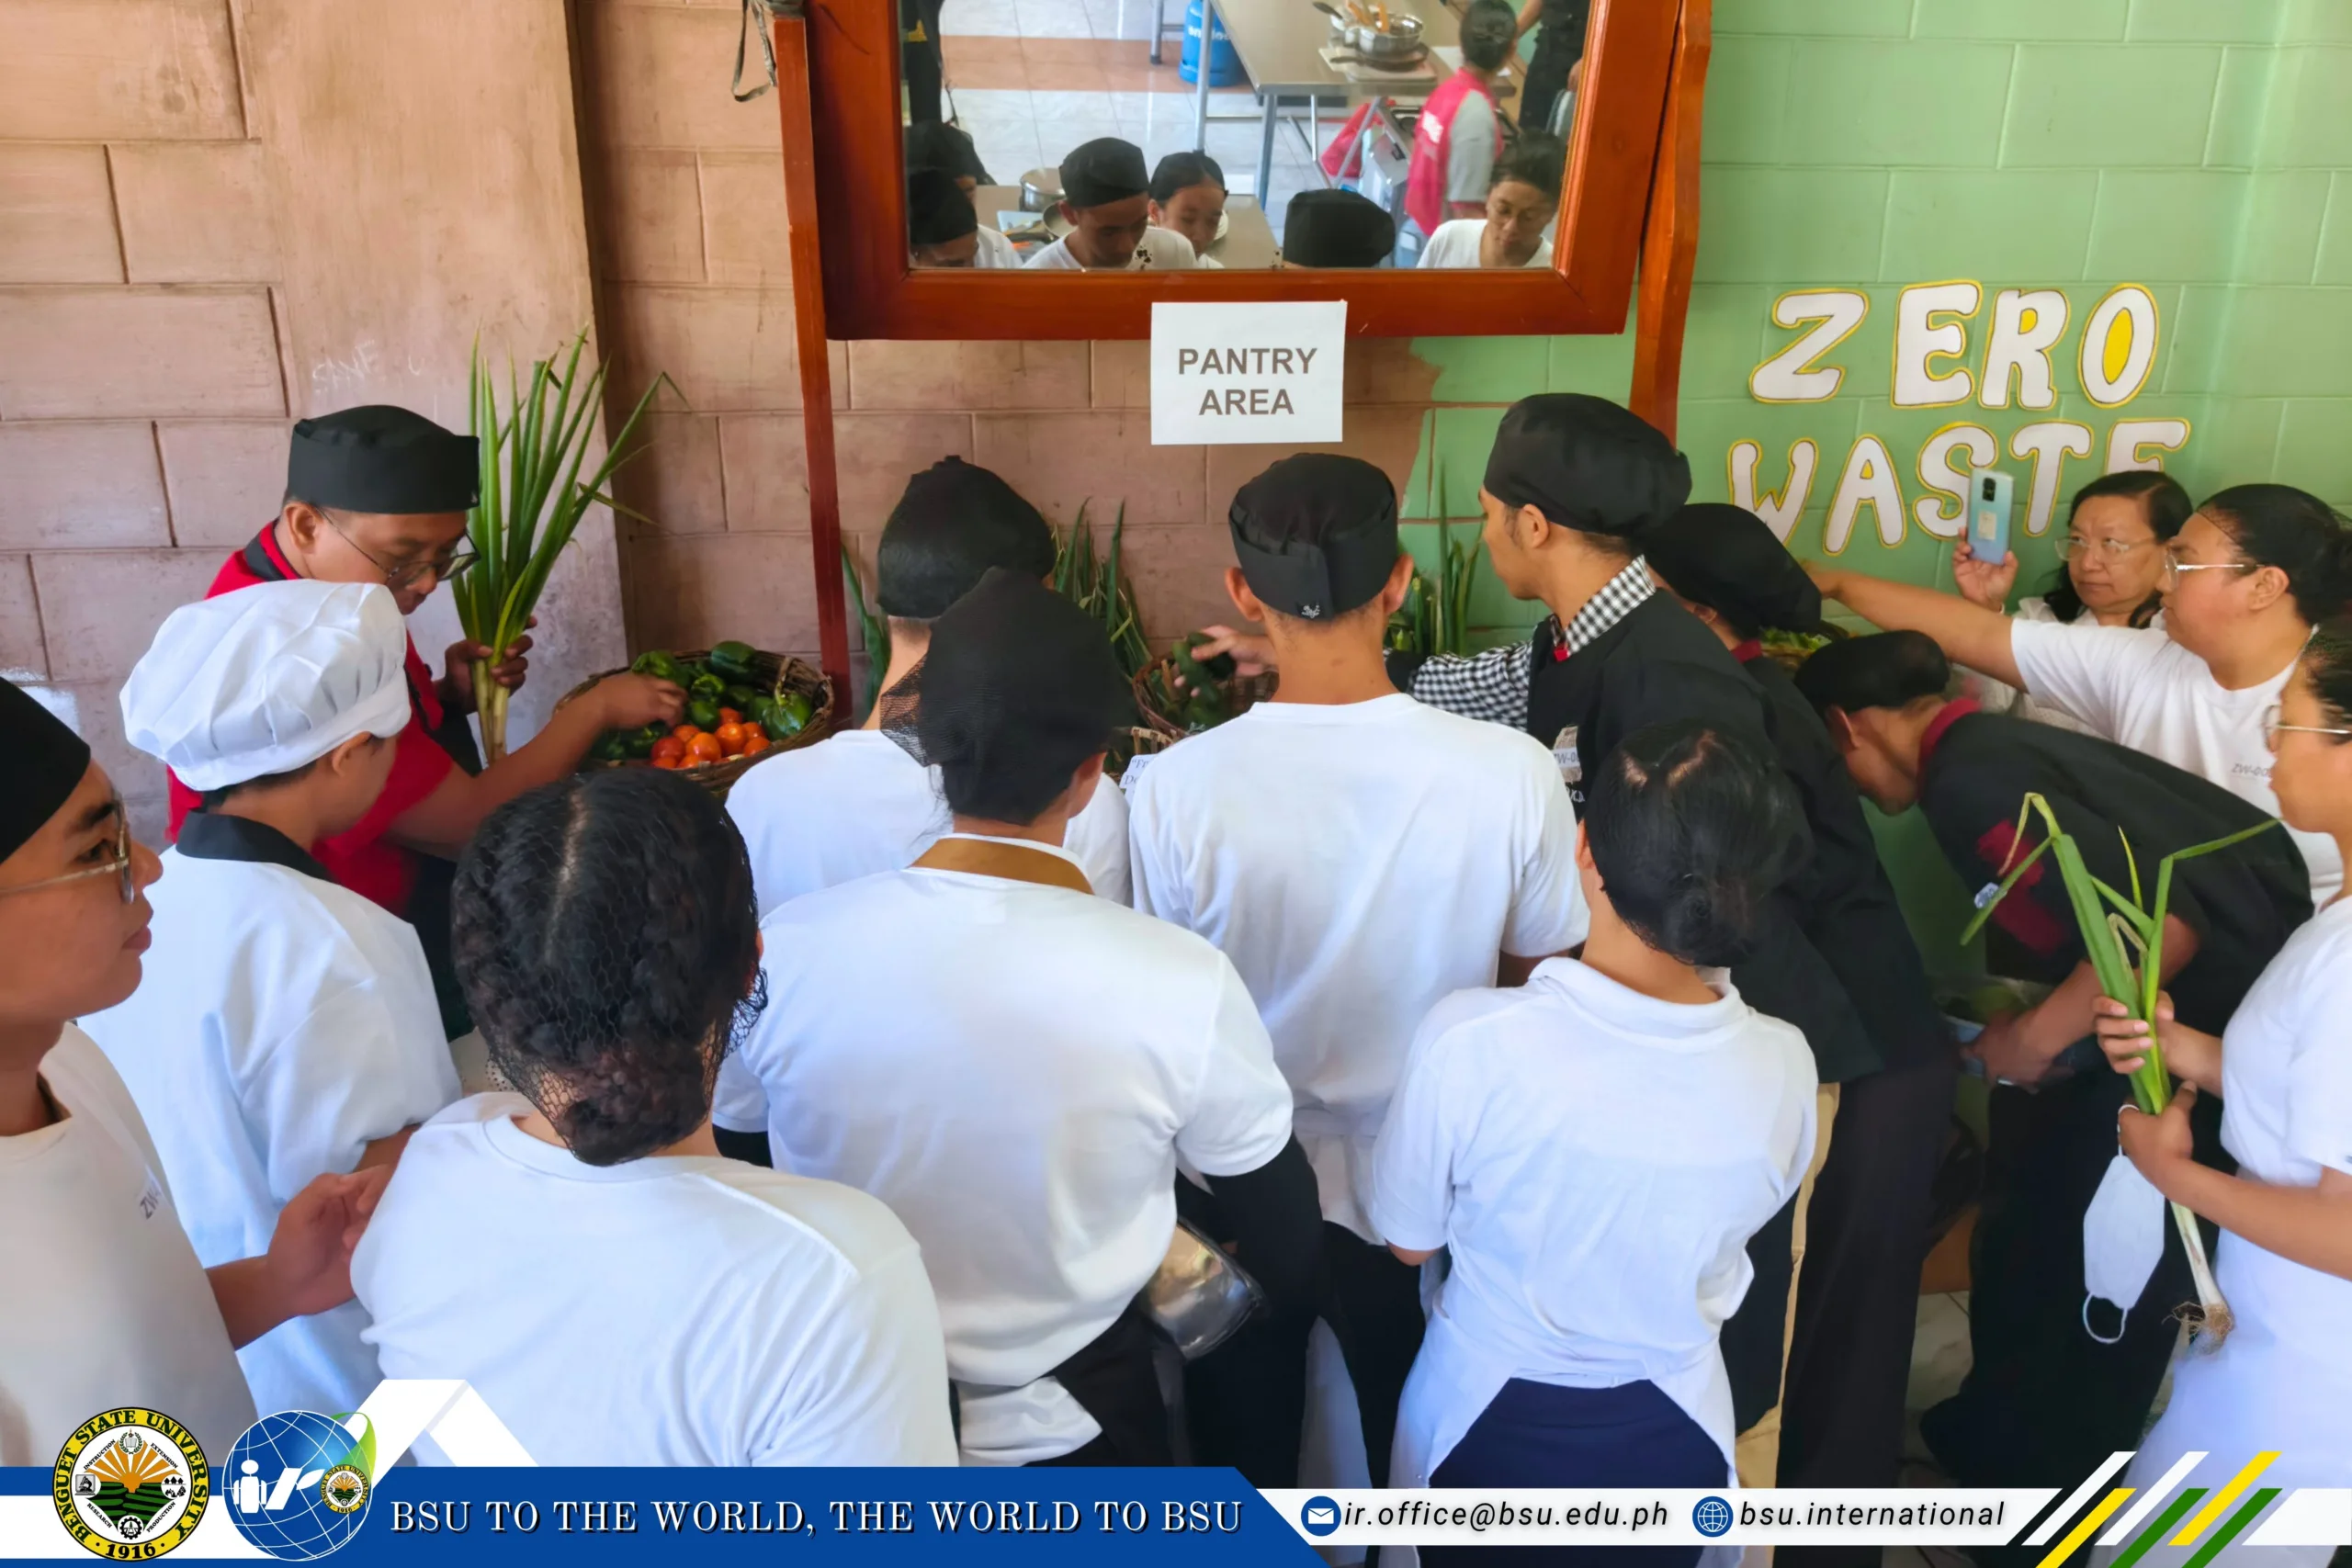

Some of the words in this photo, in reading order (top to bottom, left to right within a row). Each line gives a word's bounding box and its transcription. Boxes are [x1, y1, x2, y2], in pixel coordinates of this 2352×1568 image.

[1749, 280, 2159, 410] ZERO
[1179, 348, 1317, 375] PANTRY
[1199, 389, 1294, 415] AREA
